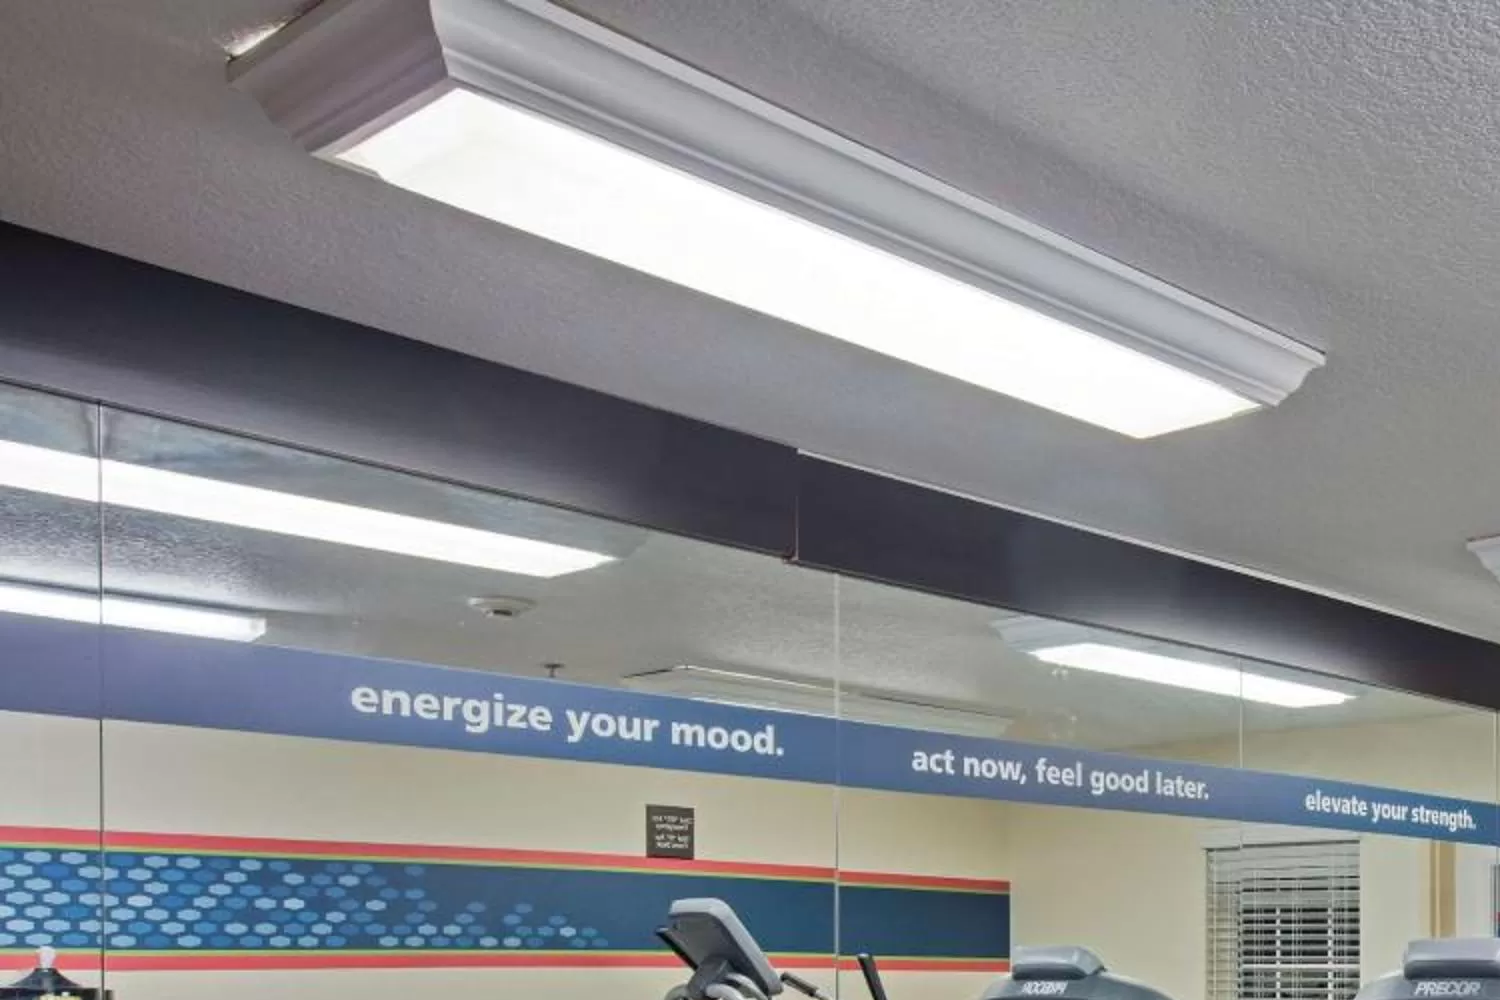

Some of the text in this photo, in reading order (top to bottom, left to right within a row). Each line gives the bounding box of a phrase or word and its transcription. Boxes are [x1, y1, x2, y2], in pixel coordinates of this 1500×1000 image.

[351, 686, 785, 757] energize your mood.
[911, 750, 1210, 800] act now, feel good later.
[1305, 789, 1477, 832] elevate your strength.
[1413, 980, 1482, 997] PRECOR
